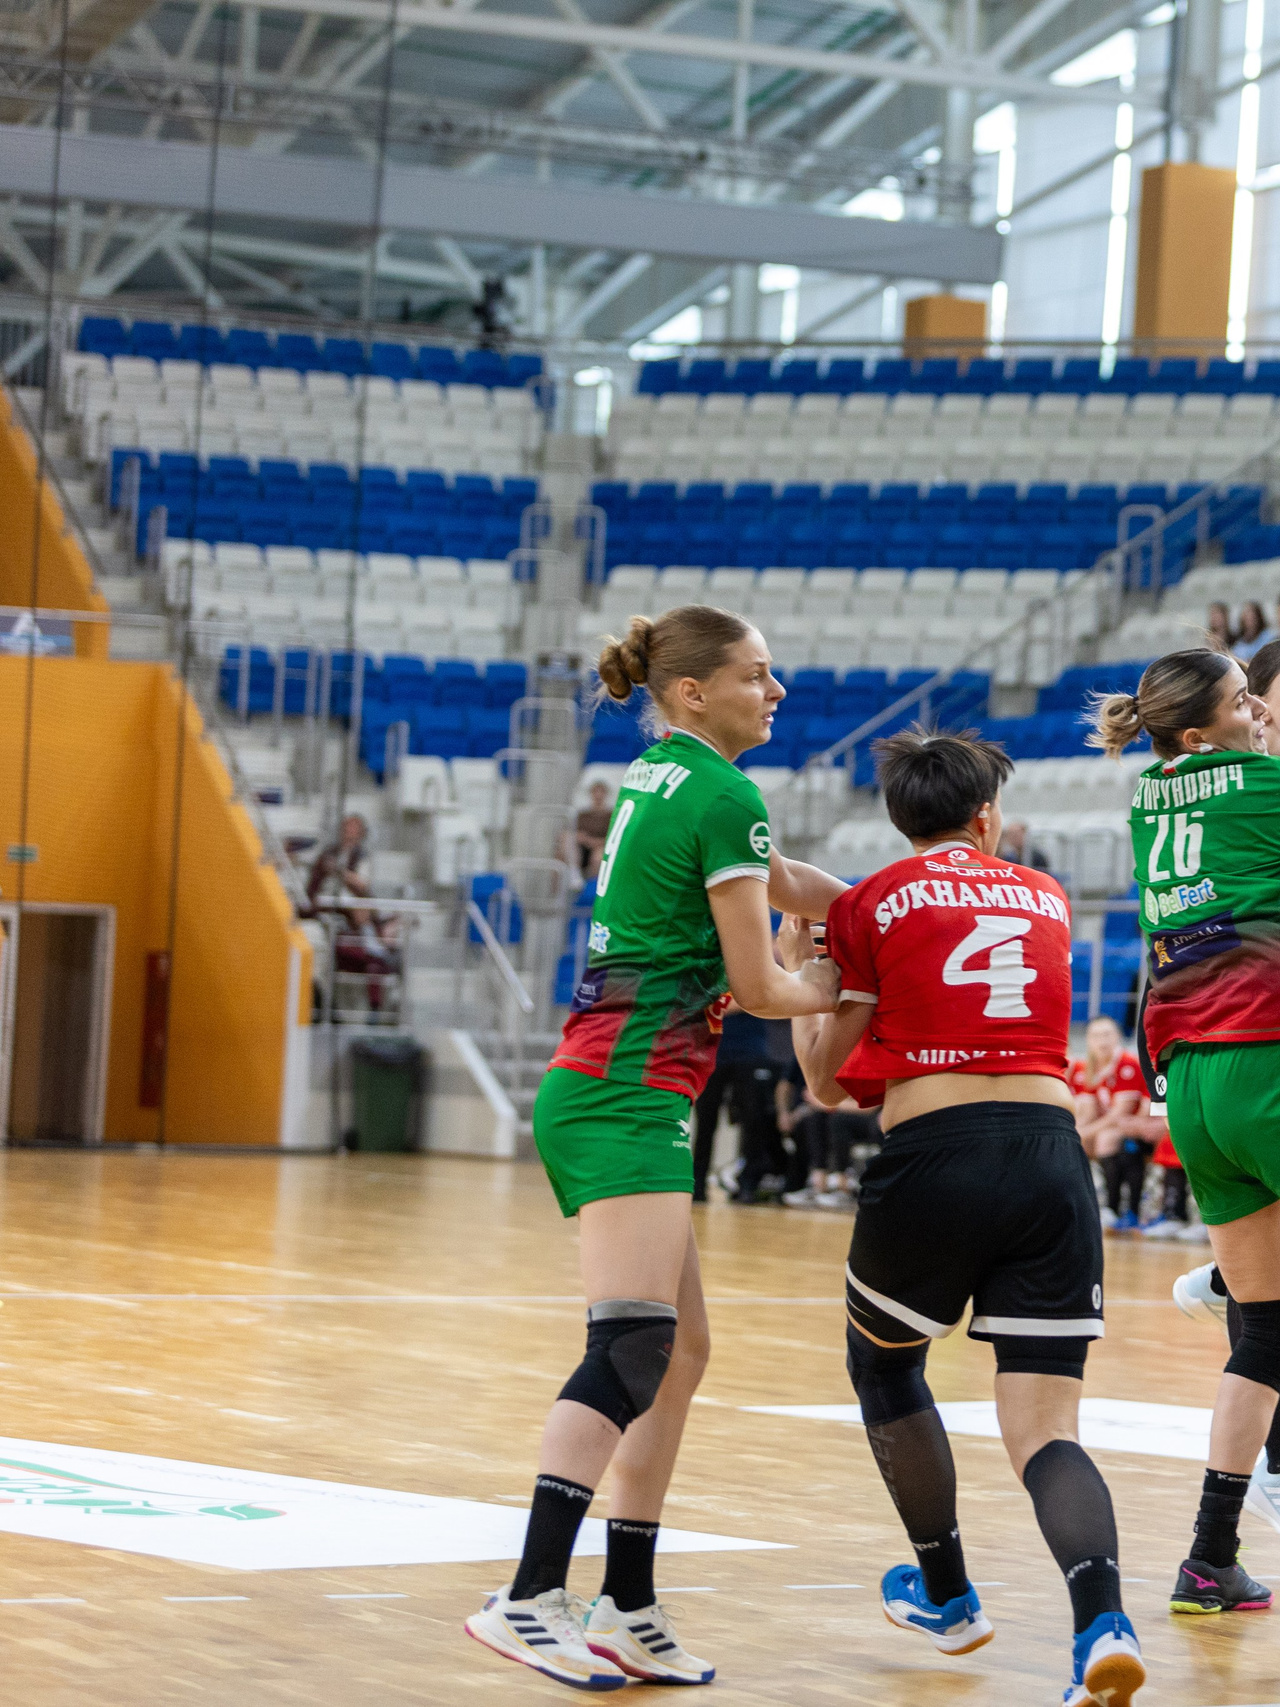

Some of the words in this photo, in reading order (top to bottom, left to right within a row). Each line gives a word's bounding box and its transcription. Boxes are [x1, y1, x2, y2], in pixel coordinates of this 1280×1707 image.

[596, 799, 635, 898] 9
[925, 861, 1022, 882] SPORTIX
[1145, 811, 1205, 883] 26
[1157, 878, 1217, 917] BelFert
[942, 915, 1037, 1017] 4
